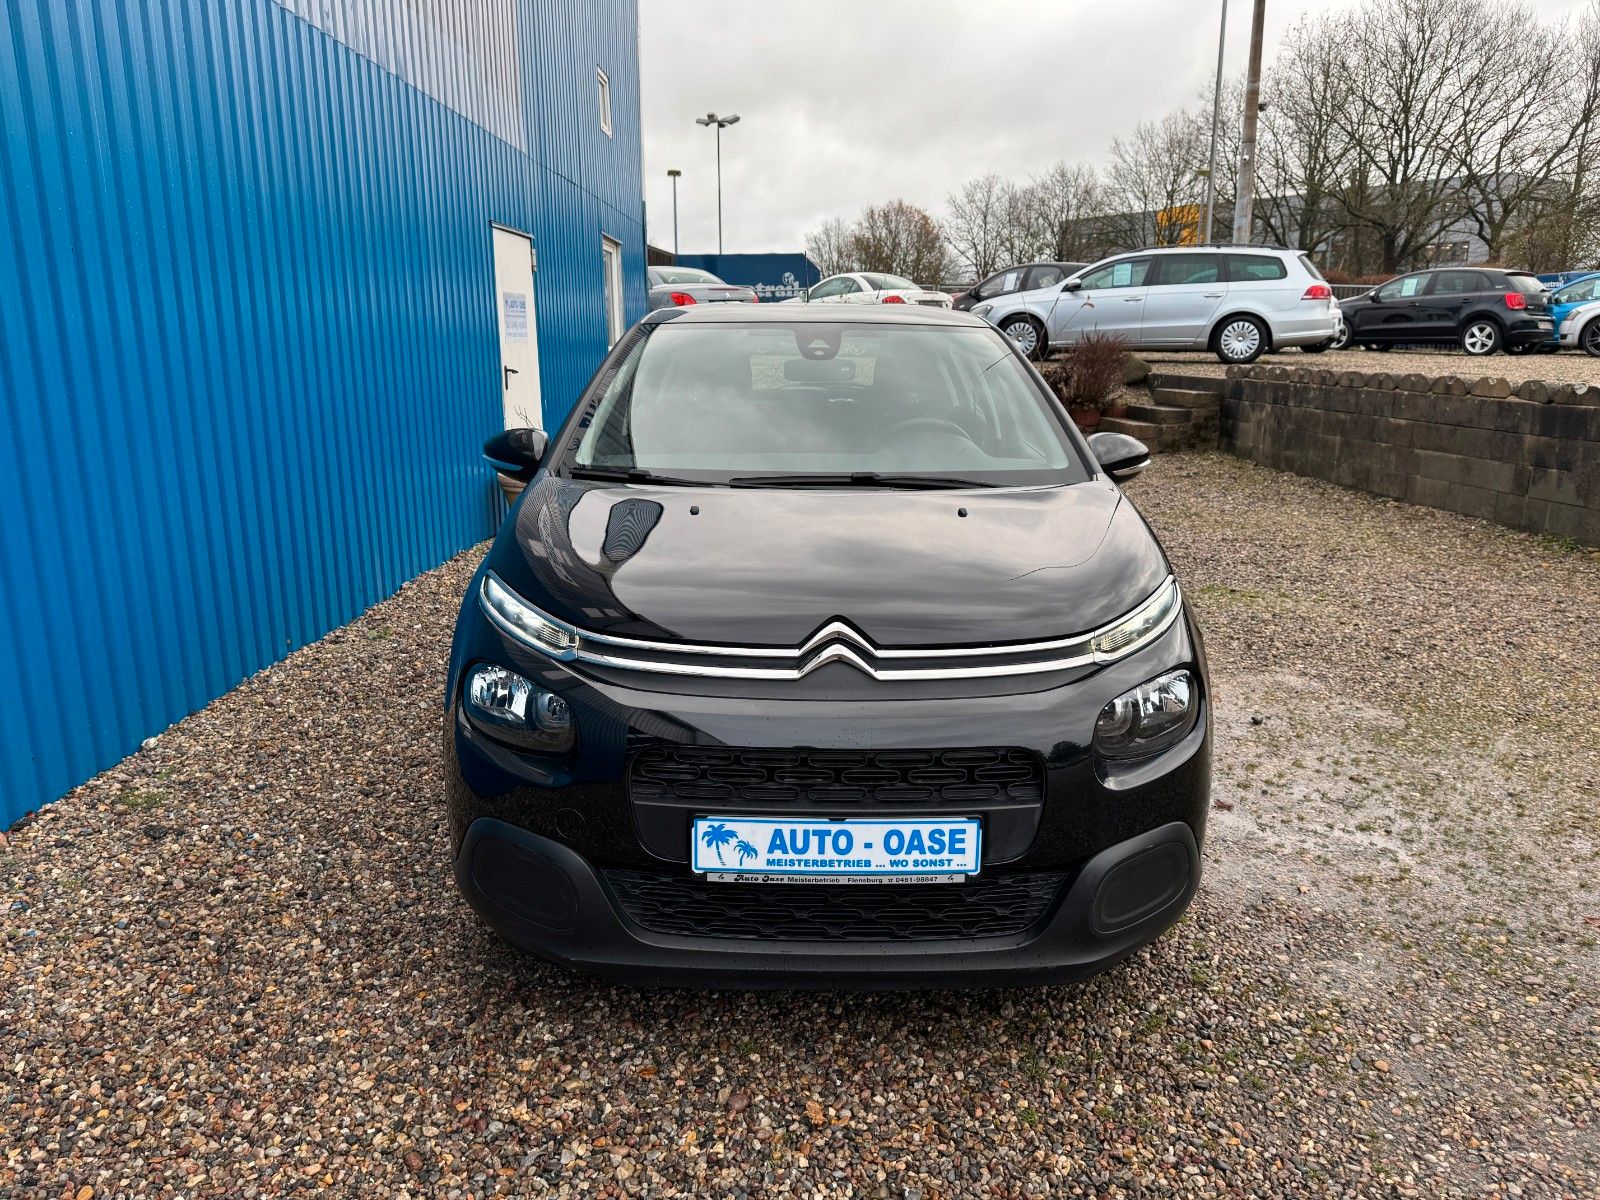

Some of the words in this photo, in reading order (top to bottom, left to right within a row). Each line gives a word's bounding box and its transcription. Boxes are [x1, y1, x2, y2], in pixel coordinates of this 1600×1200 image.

[767, 828, 854, 855] AUTO
[883, 828, 967, 855] OASE
[766, 858, 872, 868] MEISTERBETRIEB
[889, 859, 909, 868] WO
[912, 858, 954, 867] SONST
[733, 874, 759, 882] Auto
